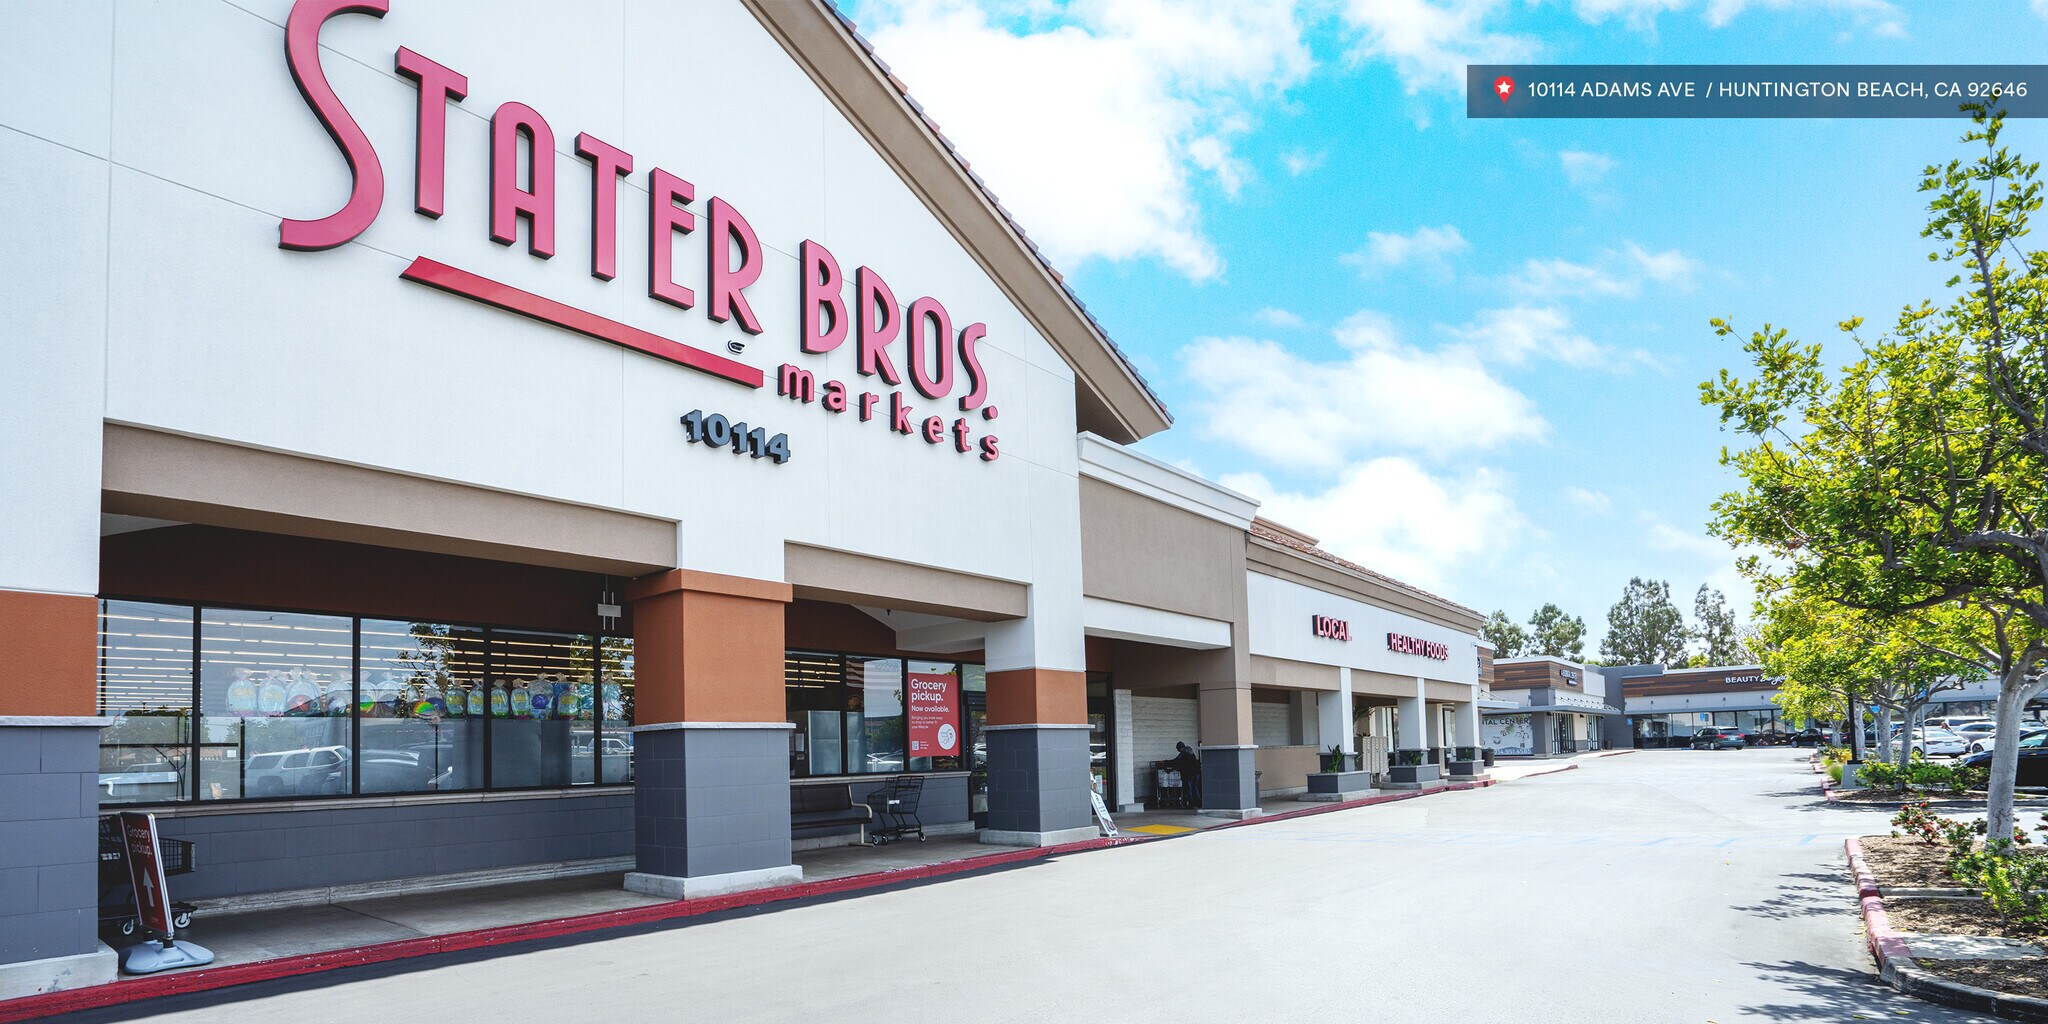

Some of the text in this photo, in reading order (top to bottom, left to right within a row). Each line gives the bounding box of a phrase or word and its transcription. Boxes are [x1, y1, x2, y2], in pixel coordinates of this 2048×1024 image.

[279, 0, 998, 422] STATER BROS.
[778, 363, 999, 461] markets
[681, 409, 791, 464] 10114
[1313, 614, 1352, 641] LOCAL
[1387, 633, 1449, 660] HEALTHY FOODS
[911, 678, 946, 692] Grocery
[1725, 676, 1760, 684] BEAUTY
[912, 690, 944, 703] pickup.
[127, 825, 150, 842] Grocery
